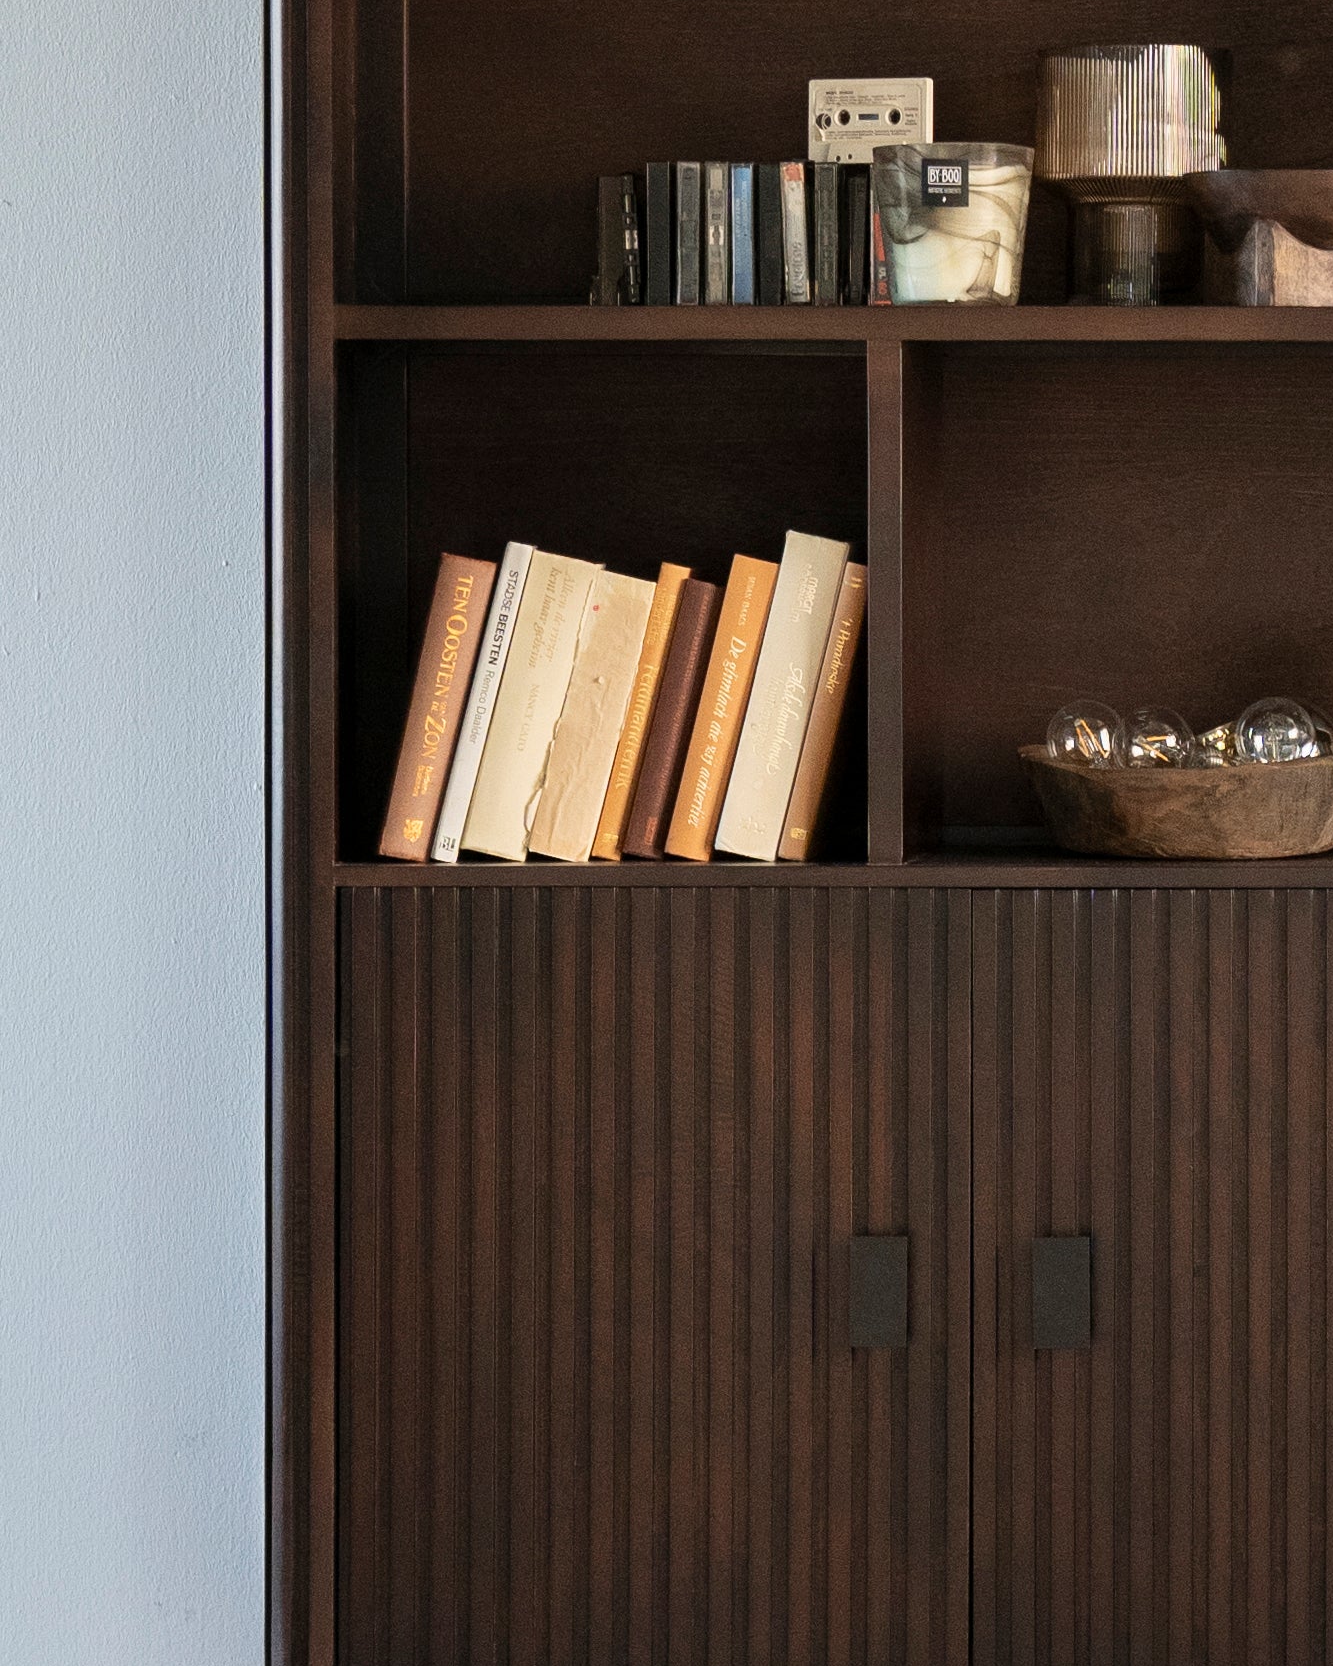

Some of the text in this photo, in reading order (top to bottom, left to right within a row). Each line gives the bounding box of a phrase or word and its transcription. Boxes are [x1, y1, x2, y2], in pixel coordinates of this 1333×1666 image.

[433, 575, 474, 699] TEN OOSTEN
[469, 569, 519, 745] STADSE BEESTEN Remco Daalder
[728, 635, 748, 660] De
[713, 659, 738, 719] glimlach
[422, 714, 447, 760] ZON
[700, 744, 717, 767] zij
[687, 766, 712, 829] achterliet
